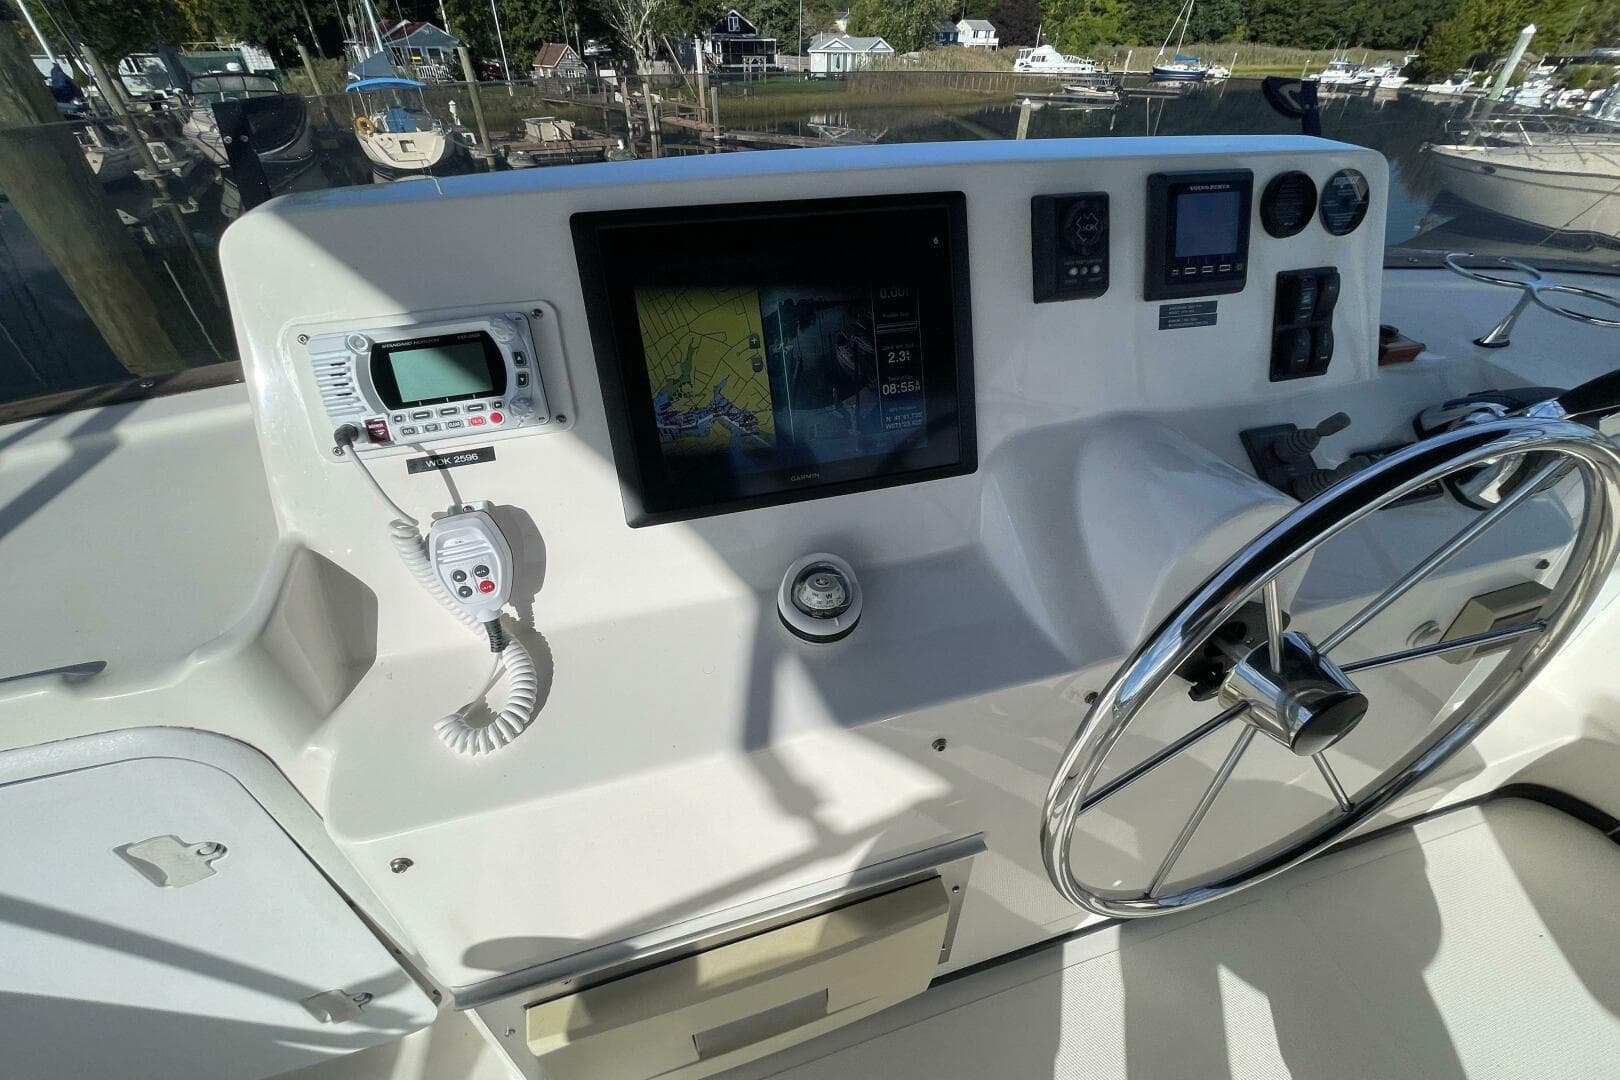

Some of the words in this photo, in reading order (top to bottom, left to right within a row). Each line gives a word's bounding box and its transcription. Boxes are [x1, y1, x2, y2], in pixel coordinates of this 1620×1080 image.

[882, 381, 914, 396] 08:55
[425, 457, 451, 468] WDK
[453, 453, 479, 464] 2596
